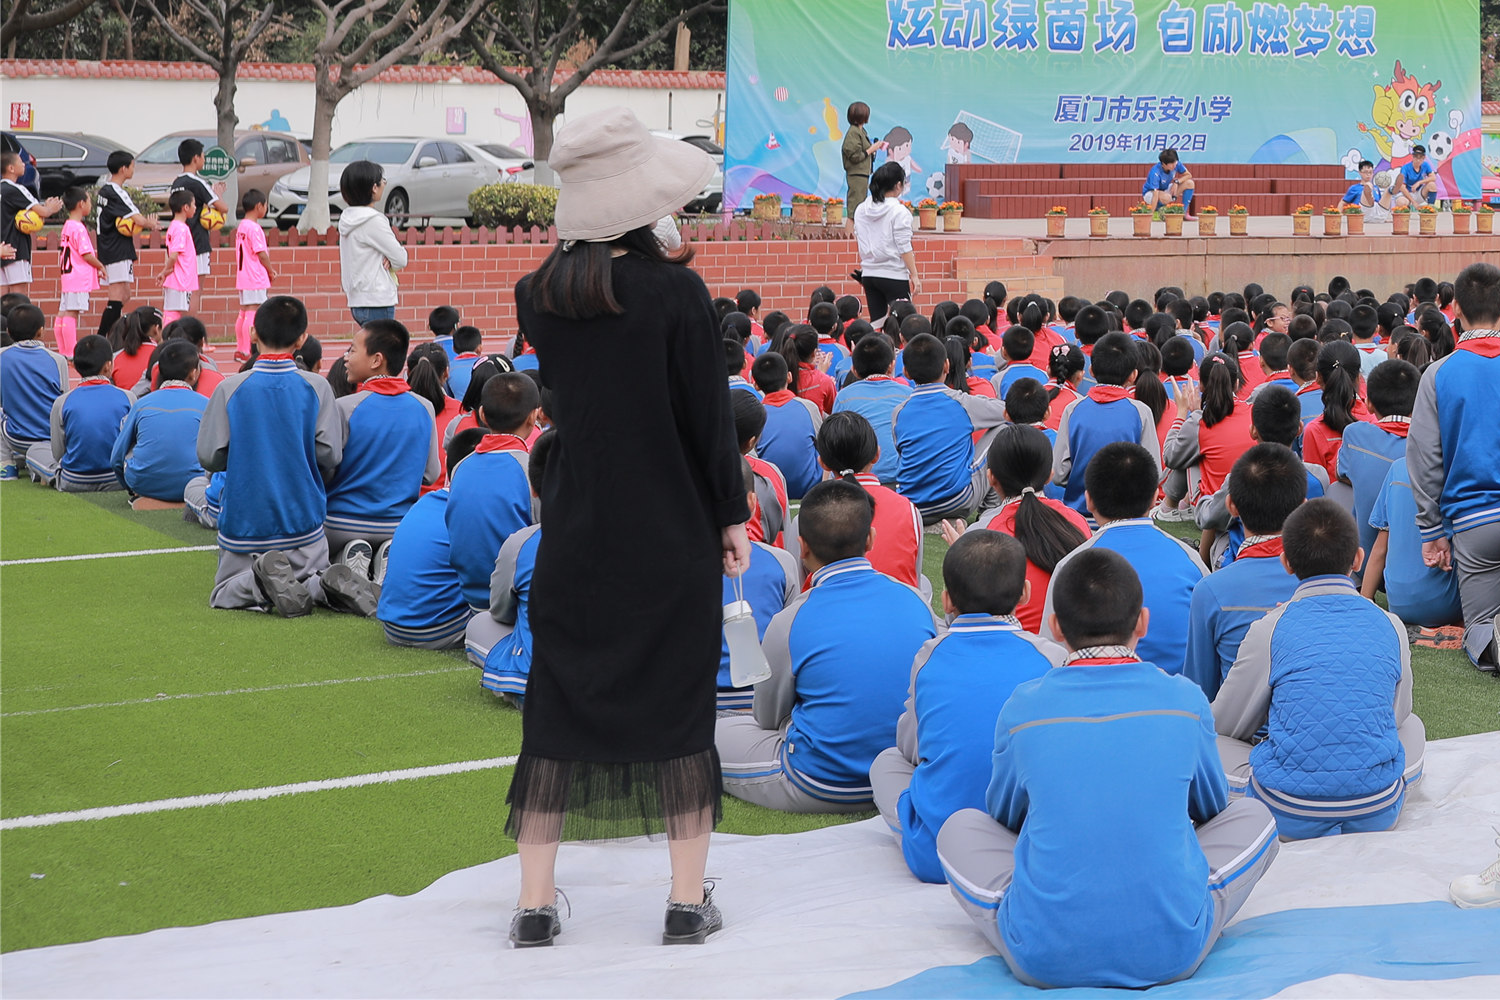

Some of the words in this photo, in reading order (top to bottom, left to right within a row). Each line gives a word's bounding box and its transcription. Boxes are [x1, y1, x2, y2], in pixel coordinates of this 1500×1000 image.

[1157, 0, 1377, 58] 自励燃梦想
[1054, 95, 1232, 123] 厦门市乐安小学
[1069, 134, 1207, 152] 2019年11月22日
